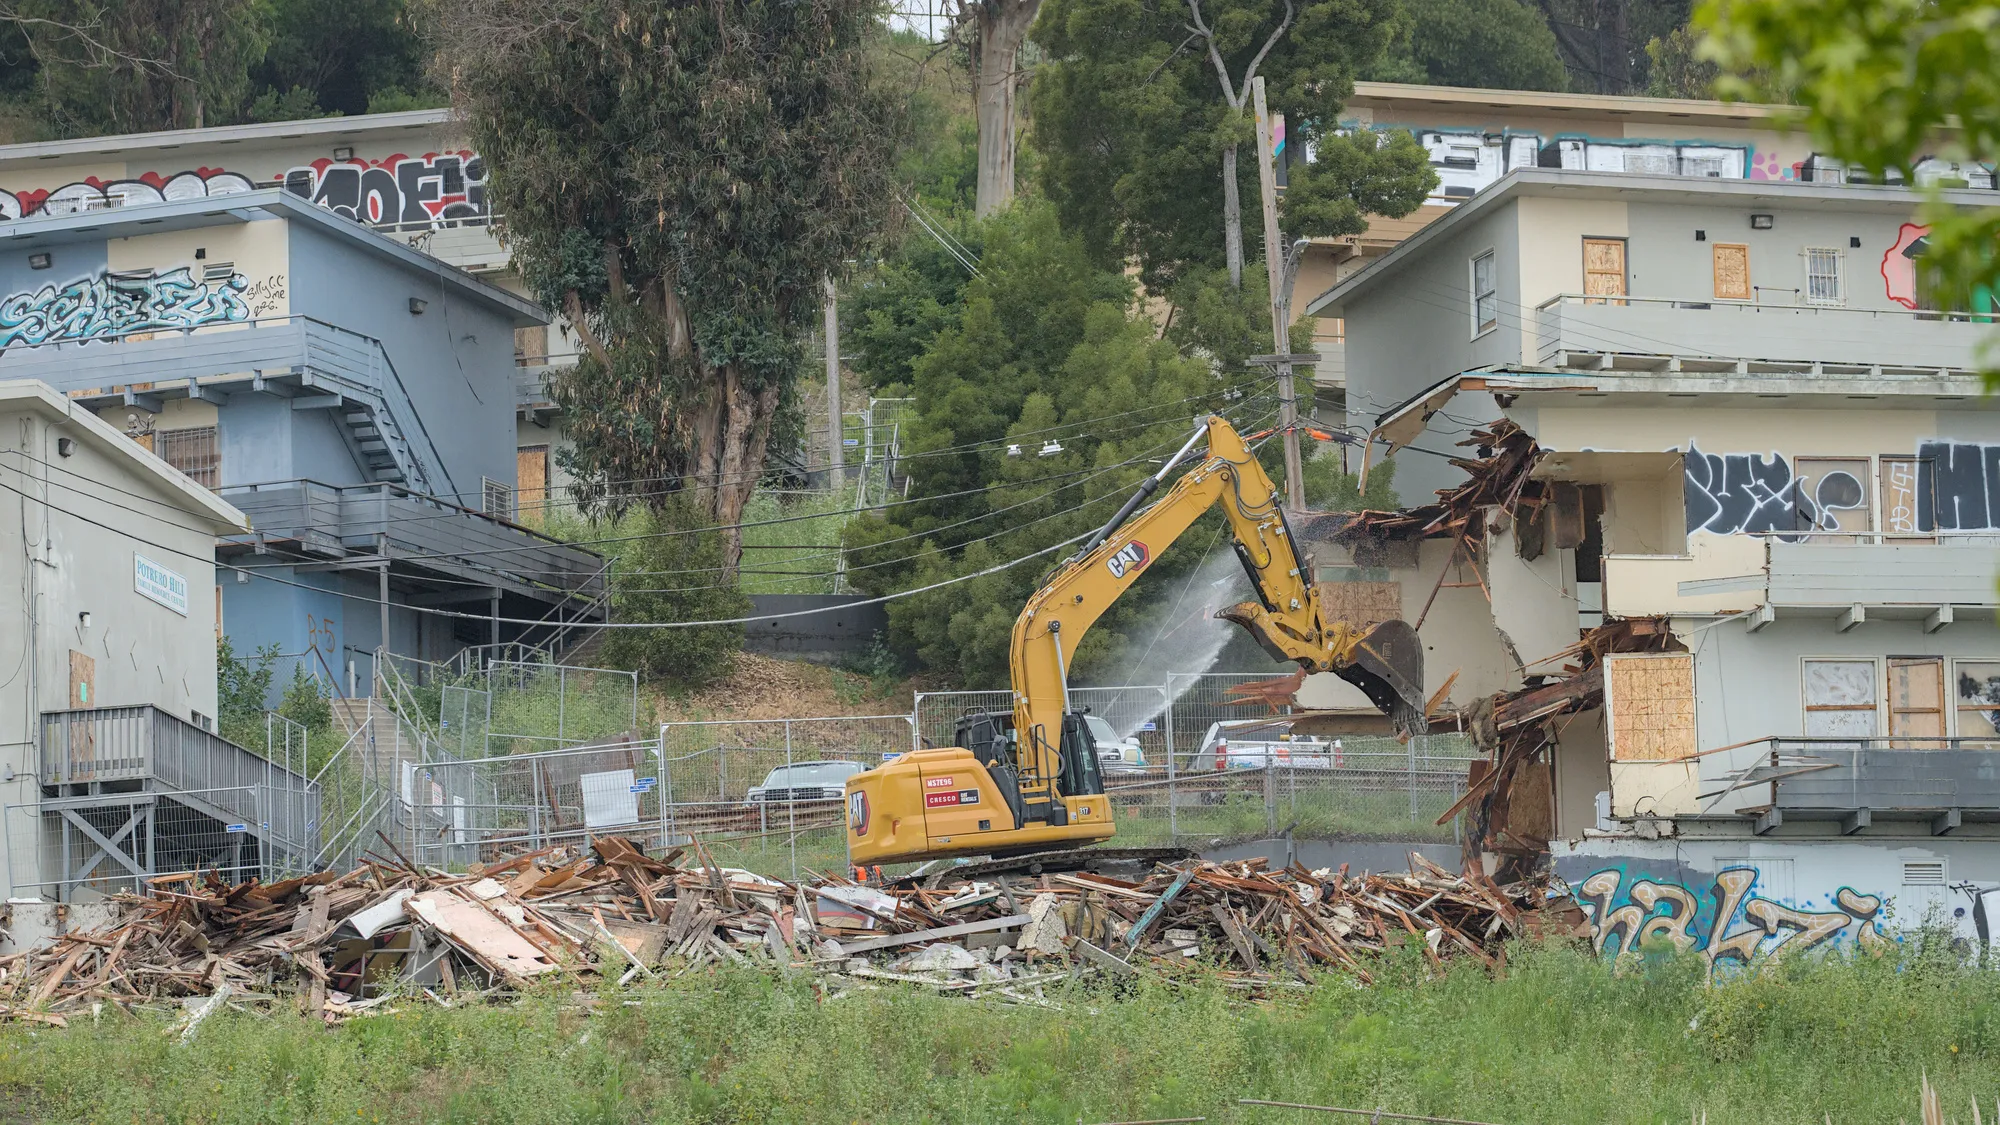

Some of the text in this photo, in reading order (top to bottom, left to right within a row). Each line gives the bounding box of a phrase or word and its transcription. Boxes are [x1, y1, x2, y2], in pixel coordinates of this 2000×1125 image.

[1106, 542, 1141, 578] CAT
[137, 560, 184, 597] POTRERO HILL
[848, 791, 864, 829] CAT
[929, 795, 956, 804] CRESCO
